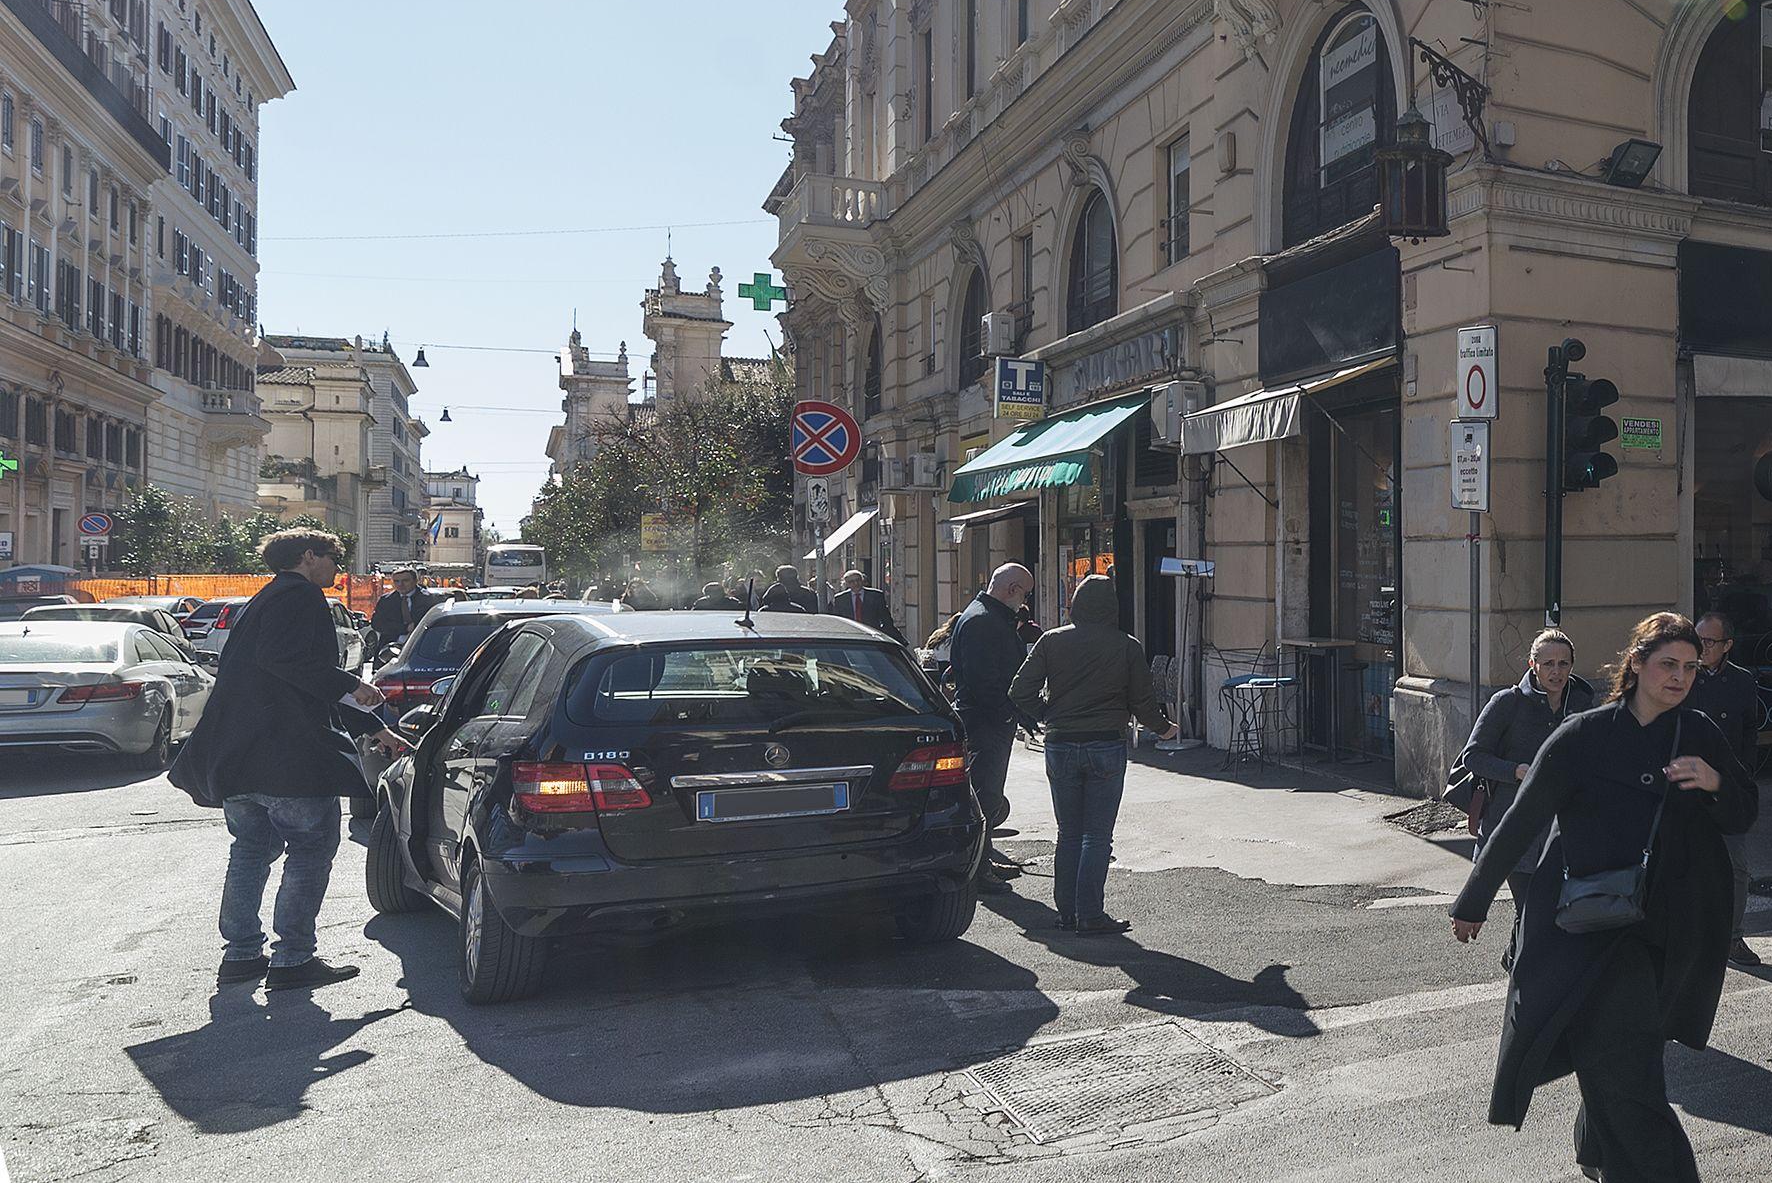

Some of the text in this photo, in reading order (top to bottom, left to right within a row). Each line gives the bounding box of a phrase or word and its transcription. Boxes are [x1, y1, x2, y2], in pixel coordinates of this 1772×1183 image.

[1007, 361, 1036, 391] T
[1001, 395, 1041, 403] TABACCHI
[1016, 404, 1041, 412] SERVICE
[1623, 419, 1659, 428] VENDESI
[916, 735, 940, 743] CDI
